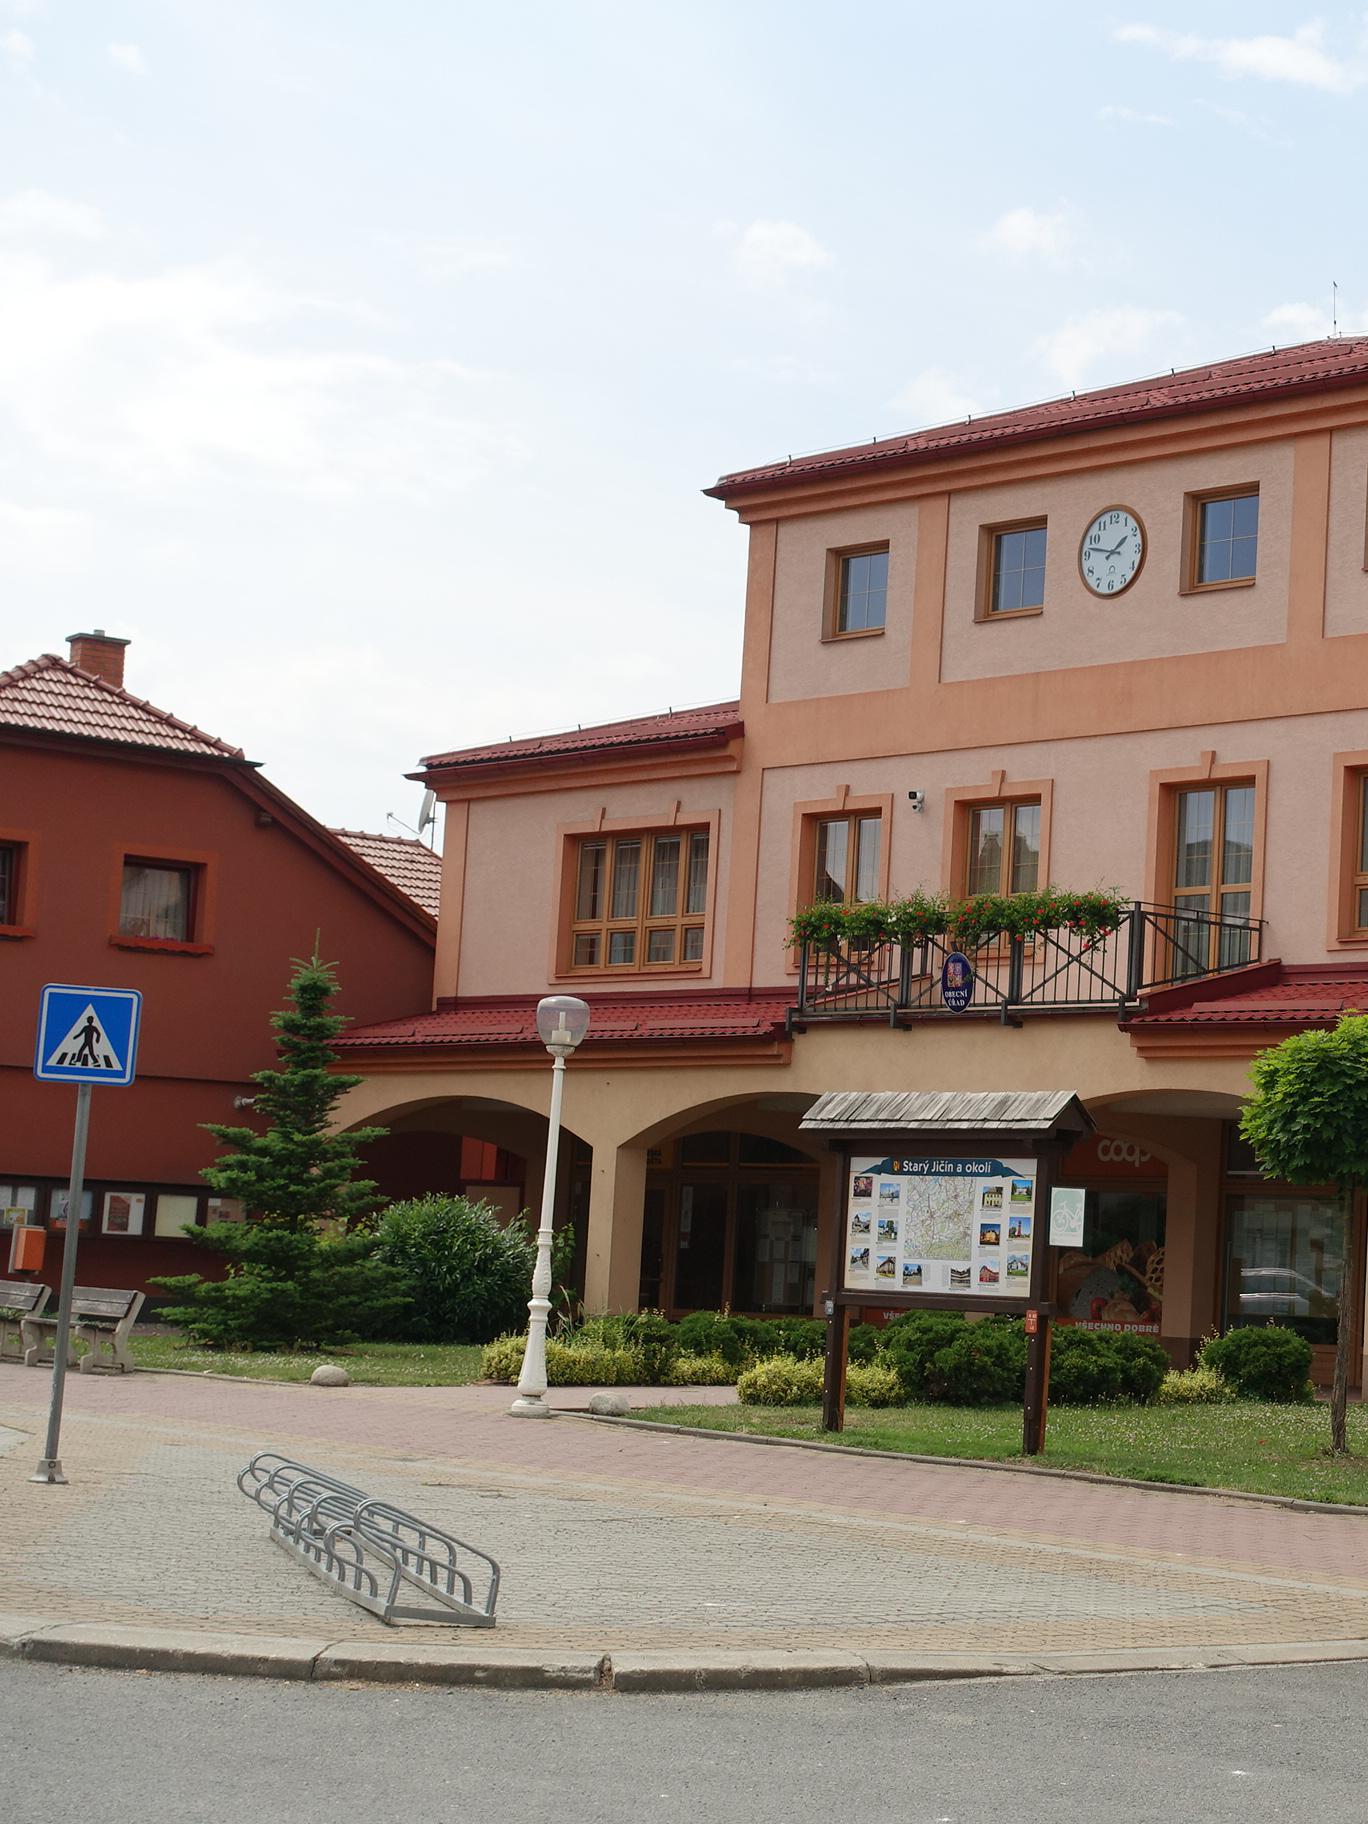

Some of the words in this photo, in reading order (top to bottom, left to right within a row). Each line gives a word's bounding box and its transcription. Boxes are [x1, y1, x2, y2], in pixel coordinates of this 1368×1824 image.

[1110, 513, 1120, 525] 12
[1124, 516, 1128, 527] 1
[1098, 520, 1107, 531] 11
[1131, 526, 1137, 537] 2
[1089, 533, 1101, 545] 10
[1134, 543, 1141, 554] 3
[1084, 550, 1091, 560] 9
[1129, 560, 1135, 571] 4
[1087, 566, 1094, 577] 8
[1096, 577, 1102, 588] 7
[1120, 574, 1127, 584] 5
[1108, 580, 1114, 591] 6
[902, 1160, 930, 1174] Starý
[931, 1161, 954, 1172] Jičín
[956, 1164, 964, 1173] a
[965, 1161, 992, 1173] okolí
[1124, 1323, 1160, 1334] DOBRÉ
